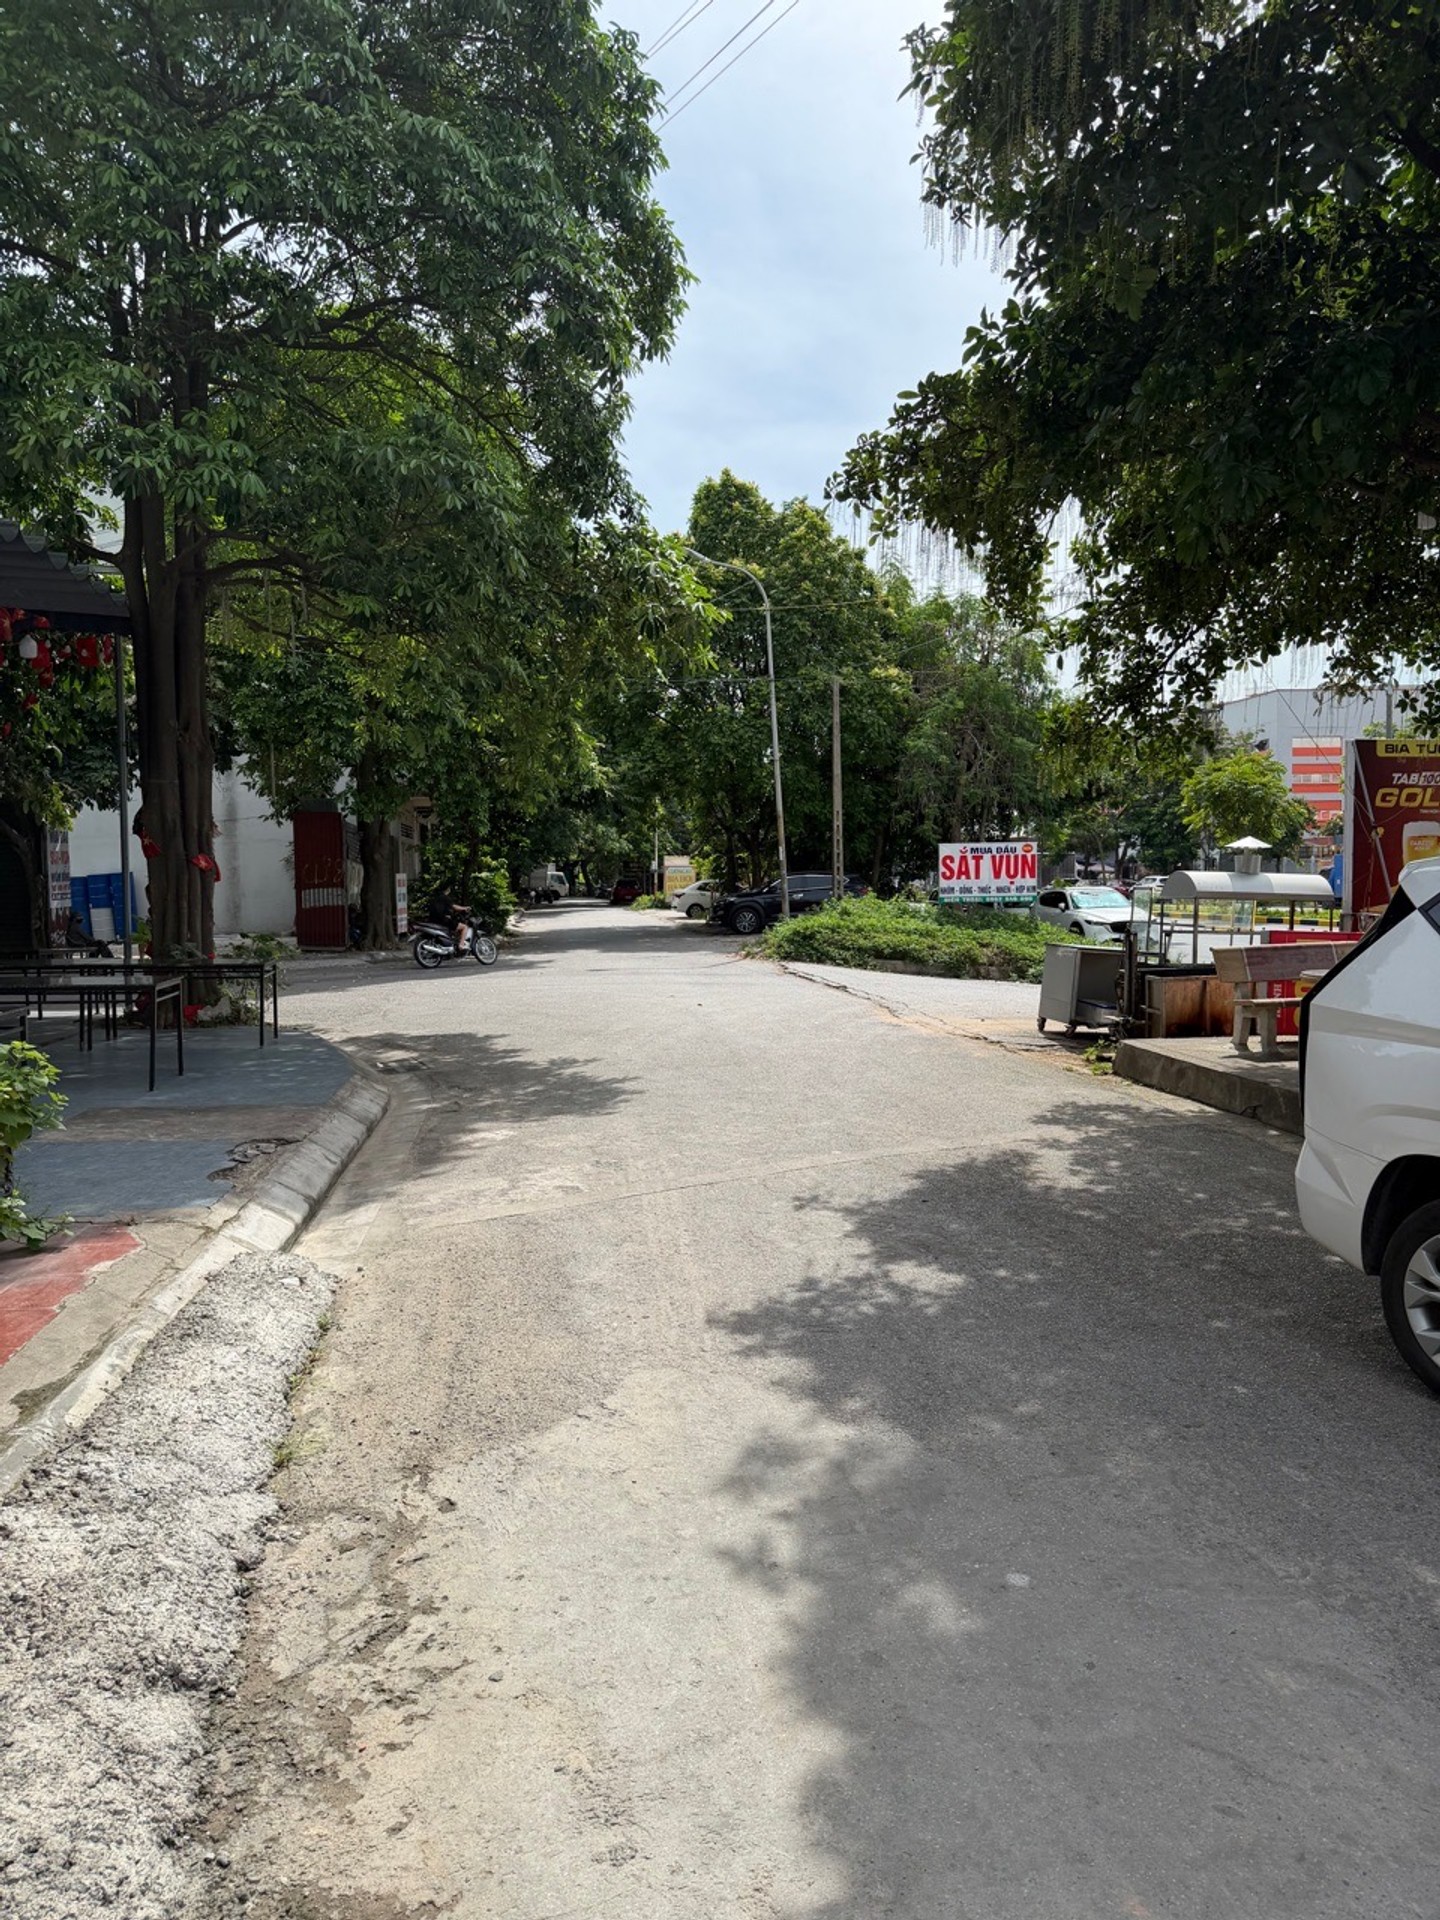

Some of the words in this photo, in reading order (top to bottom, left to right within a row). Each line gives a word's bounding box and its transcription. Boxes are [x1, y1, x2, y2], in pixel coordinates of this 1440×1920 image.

[1385, 744, 1410, 754] BIA
[970, 847, 993, 855] MUA
[941, 846, 984, 881] SẮT
[990, 853, 1036, 885] VỤN
